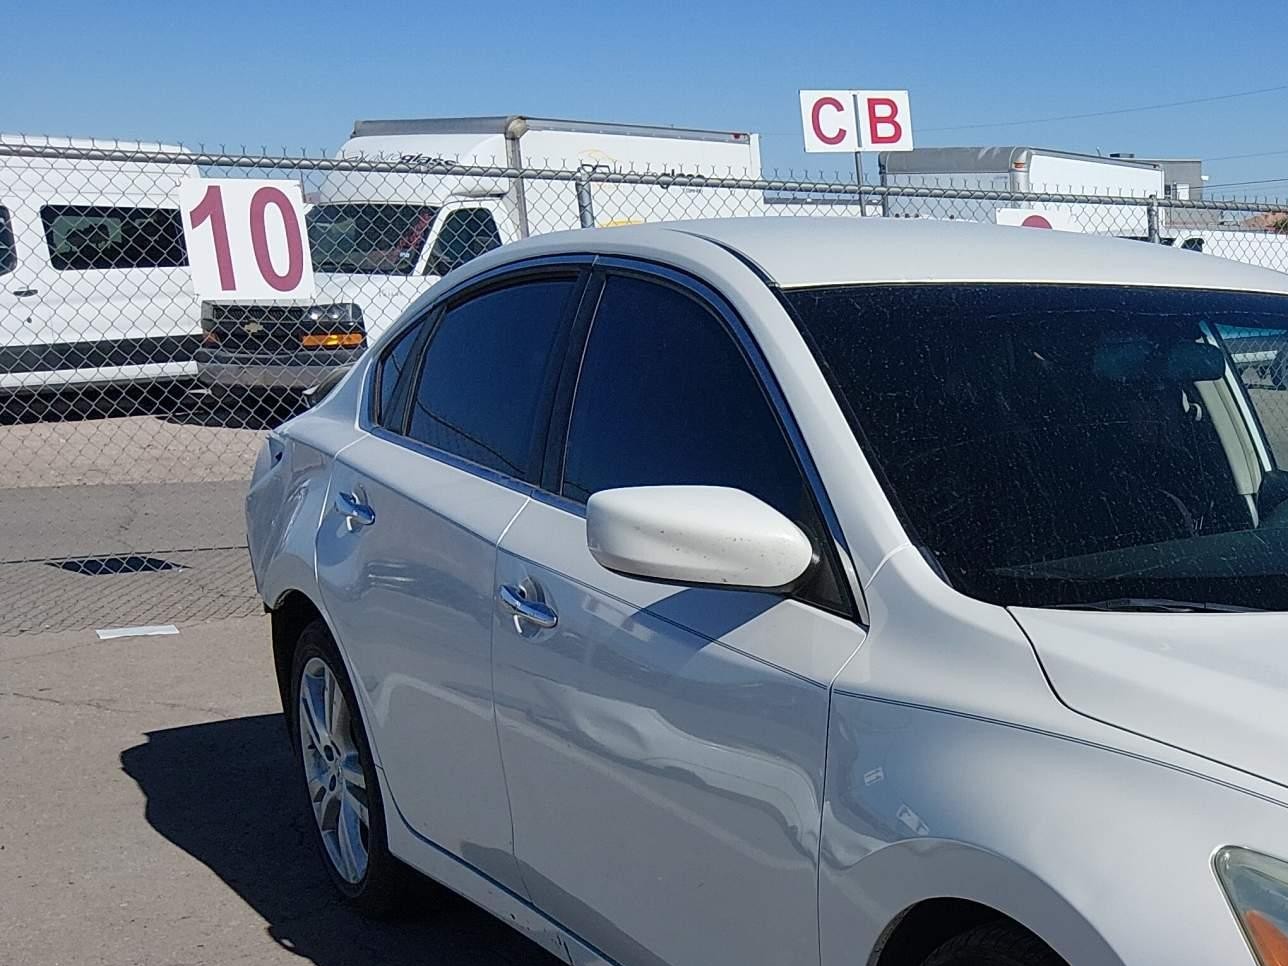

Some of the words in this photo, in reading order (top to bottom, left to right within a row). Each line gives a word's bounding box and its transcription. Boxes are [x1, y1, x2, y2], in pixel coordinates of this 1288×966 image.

[811, 96, 847, 145] C
[866, 97, 903, 145] B
[191, 187, 303, 291] 10
